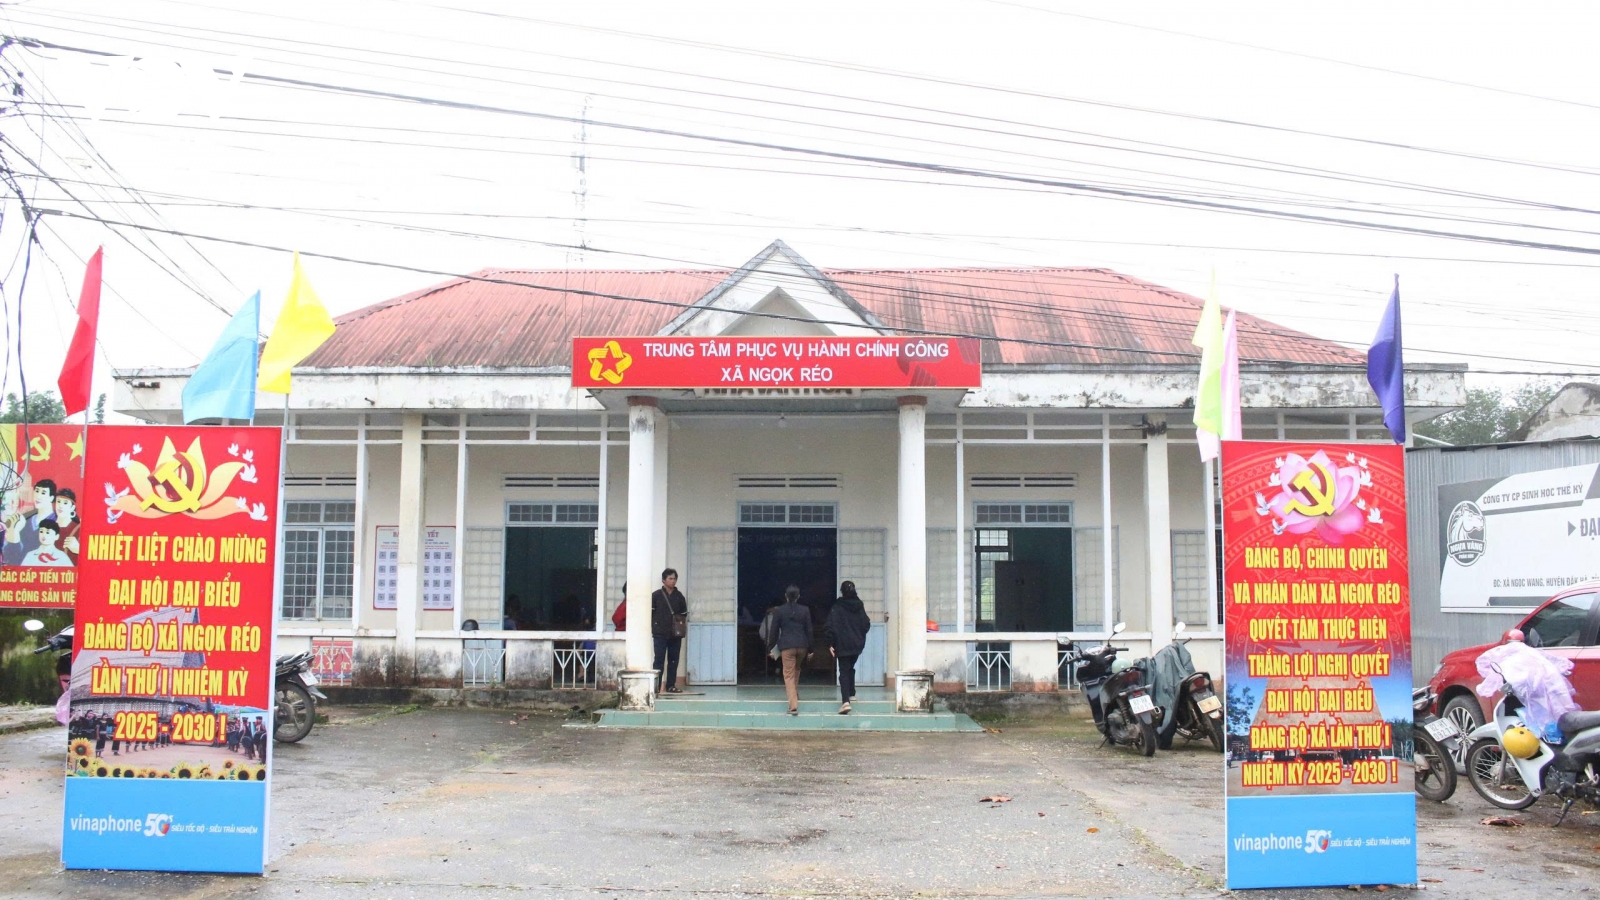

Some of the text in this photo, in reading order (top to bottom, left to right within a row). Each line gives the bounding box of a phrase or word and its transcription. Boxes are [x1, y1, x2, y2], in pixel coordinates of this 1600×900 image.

[644, 340, 948, 360] TRUNG TÂM PHỤC VỤ HÀNH CHÍNH CÔNG
[722, 365, 832, 384] XÃ NGỌK RÉO
[1502, 493, 1510, 502] TY
[1512, 492, 1521, 501] CP
[1522, 490, 1539, 500] SINH
[87, 531, 267, 566] NHIỆT LIỆT CHÀO MỪNG
[1244, 542, 1388, 572] ĐẢNG BỘ, CHÍNH QUYỀN
[0, 568, 75, 584] CÁC CẤP TIẾN TỚI
[15, 588, 40, 604] CỘNG
[41, 588, 60, 603] SẢN
[108, 572, 241, 611] ĐẠI HỘI ĐẠI BIỂU
[1233, 579, 1401, 607] VÀ NHÂN DÂN XÃ NGỌK RÉO
[83, 616, 261, 656] ĐẢNG BỘ XÃ NGỌK RÉO
[1249, 612, 1387, 643] QUYẾT TÂM THỰC HIỆN
[1248, 647, 1390, 680] THẮNG LỢI NGHỊ QUYẾT
[92, 660, 249, 700] LẦN THỨ I NHIỆM KỲ
[1267, 684, 1373, 716] ĐẠI HỘI ĐẠI BIỂU
[115, 712, 158, 740] 2025
[172, 713, 216, 741] 2030
[1250, 719, 1390, 751] ĐẢNG BỘ XÃ LẦN THỨ I
[1243, 760, 1284, 789] NHIỆM
[1287, 760, 1305, 785] KỲ
[1307, 761, 1341, 784] 2025
[1352, 760, 1387, 783] 2030
[71, 814, 142, 835] vinaphone
[1234, 833, 1303, 854] vinaphone
